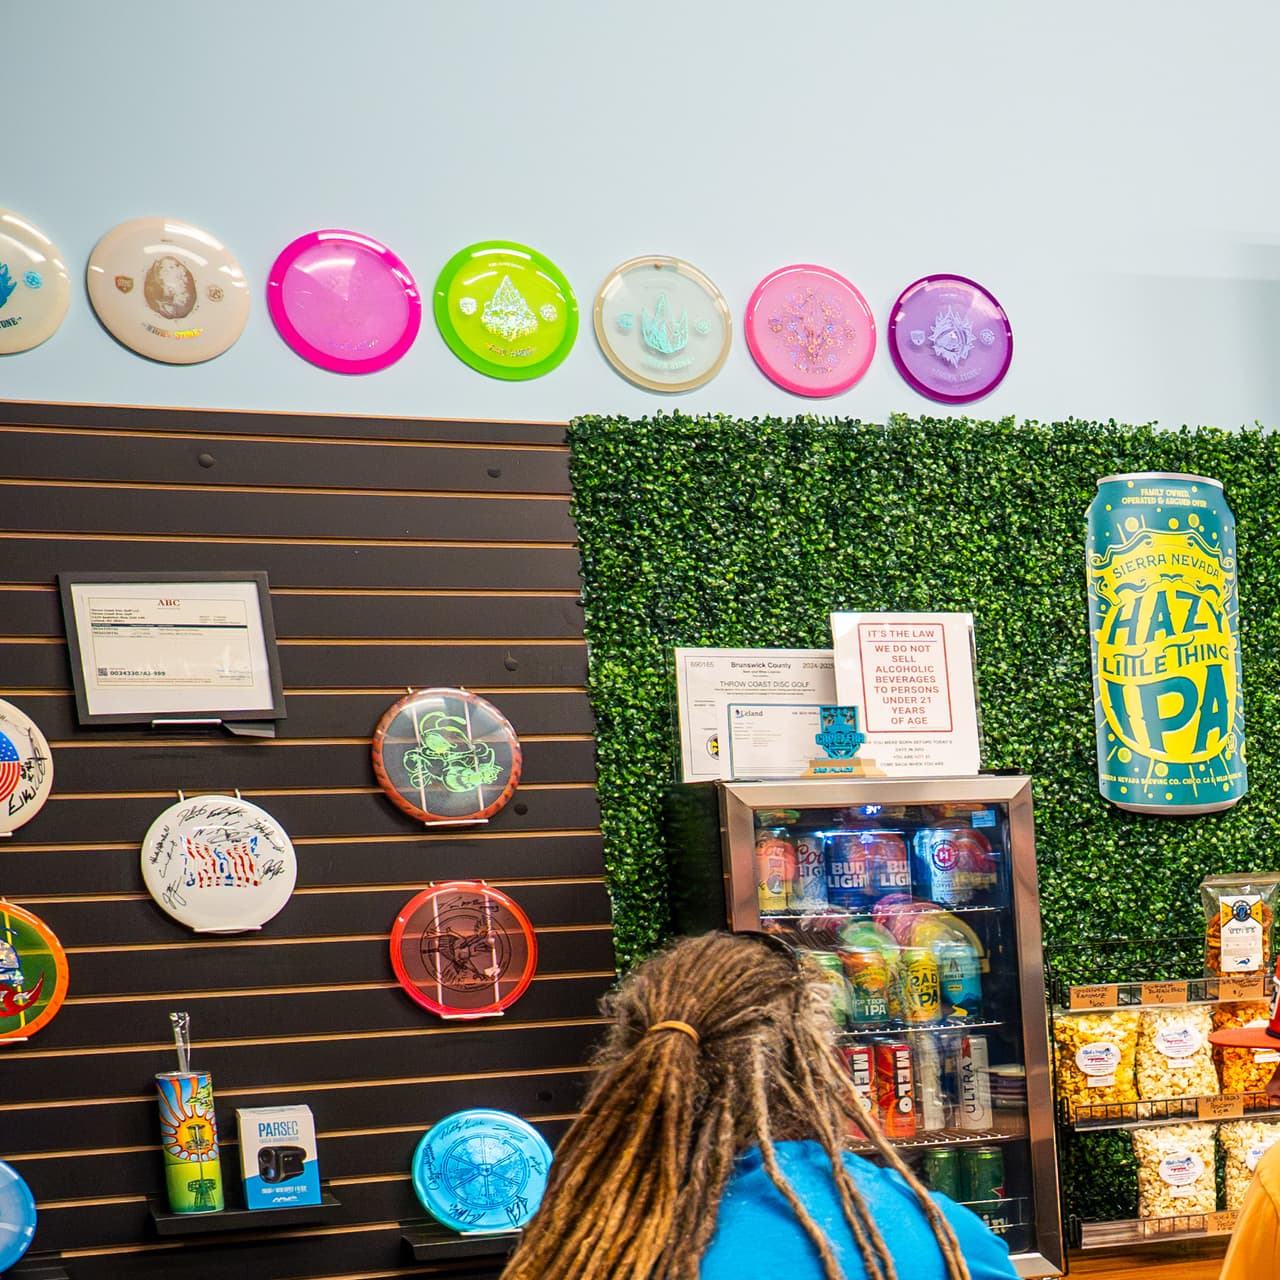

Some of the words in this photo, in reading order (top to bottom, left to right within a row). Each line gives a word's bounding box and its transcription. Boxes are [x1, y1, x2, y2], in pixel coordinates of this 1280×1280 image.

[1112, 553, 1167, 580] SIERRA
[1171, 554, 1219, 580] NEVADA
[1107, 590, 1224, 645] HAZY
[868, 630, 887, 638] IT'S
[889, 630, 910, 638] THE
[912, 629, 935, 637] LAW
[1163, 638, 1229, 667] THING
[1104, 664, 1229, 755] IPA
[832, 862, 865, 875] BUD
[886, 861, 910, 873] BU
[865, 1006, 887, 1016] IPA
[895, 1051, 913, 1113] MELO
[962, 1062, 976, 1114] ULTRA
[258, 1121, 299, 1137] PARSEC
